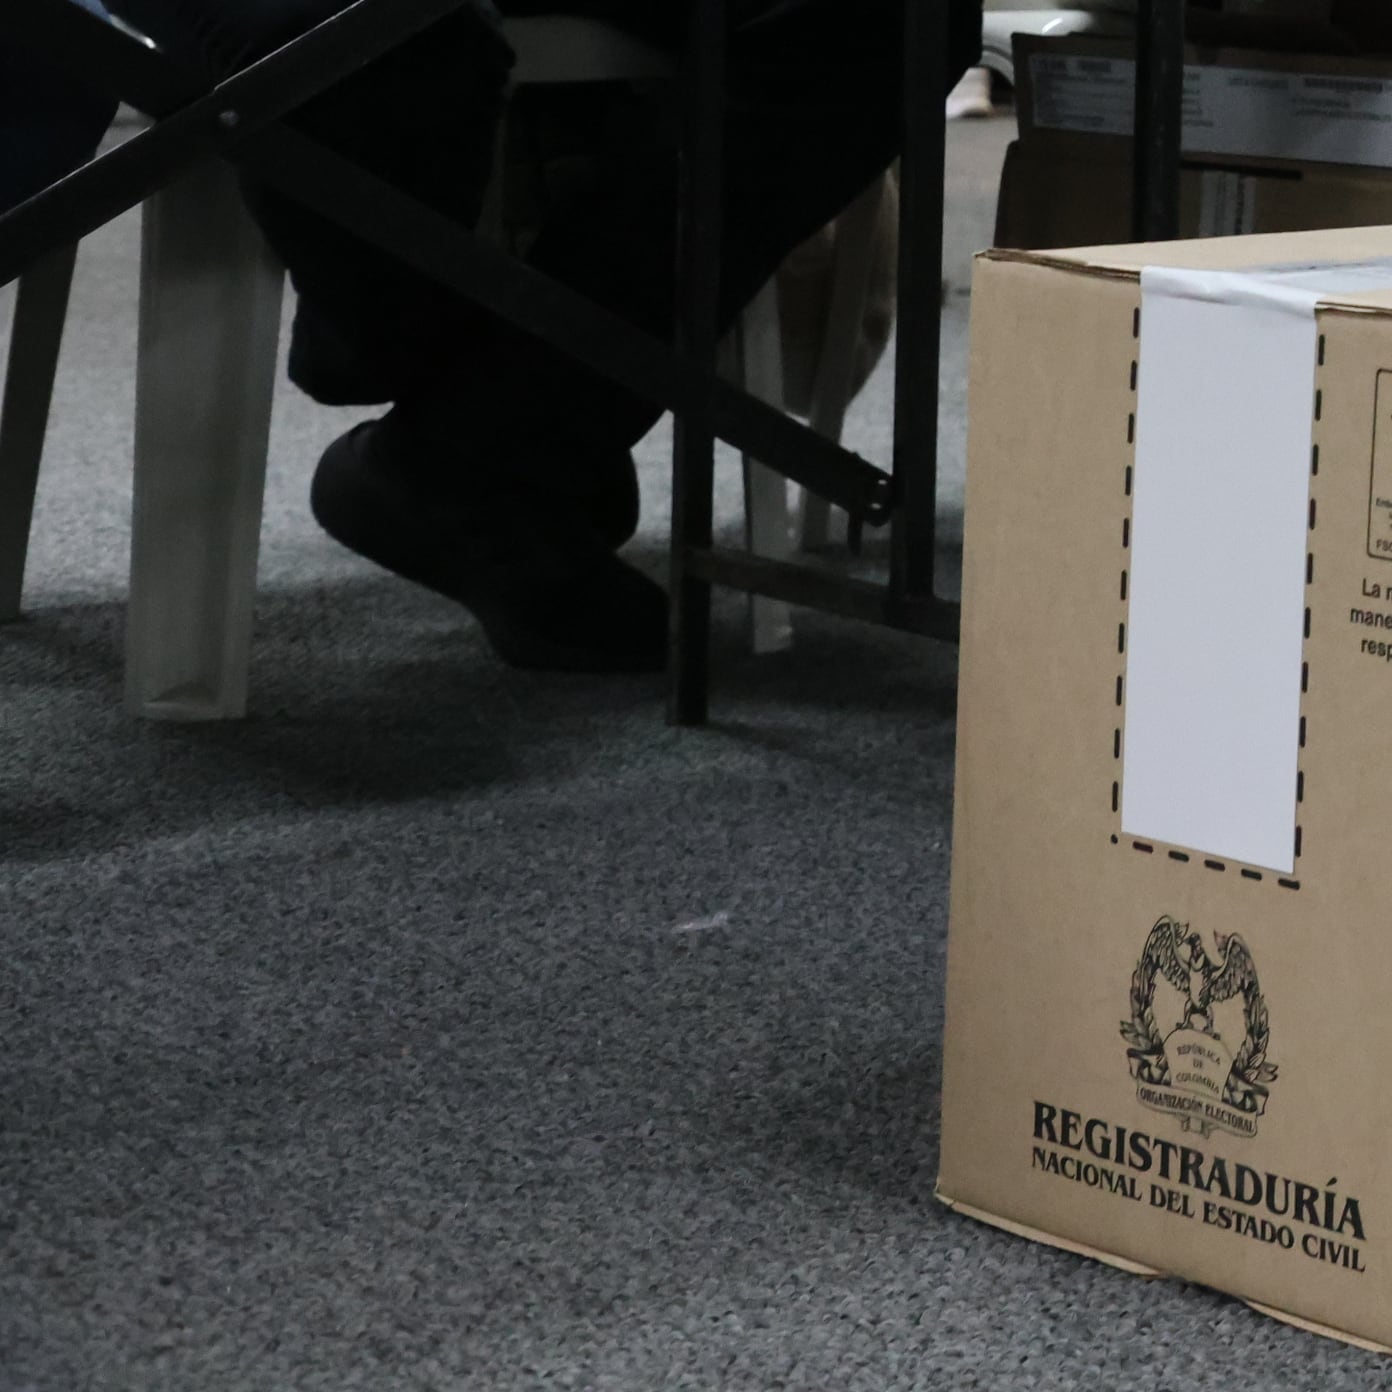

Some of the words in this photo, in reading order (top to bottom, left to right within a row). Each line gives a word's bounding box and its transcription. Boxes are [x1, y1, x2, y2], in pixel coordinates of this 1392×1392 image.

[1362, 578, 1381, 598] La
[1140, 1087, 1203, 1114] ORGANIZACIÓN
[1205, 1106, 1254, 1133] ELECTORAL
[1031, 1146, 1143, 1202] NACIONAL
[1149, 1183, 1195, 1219] DEL
[1203, 1200, 1294, 1250] ESTADO
[1301, 1233, 1366, 1273] CIVIL
[1033, 1100, 1366, 1241] REGISTRADURÍA
